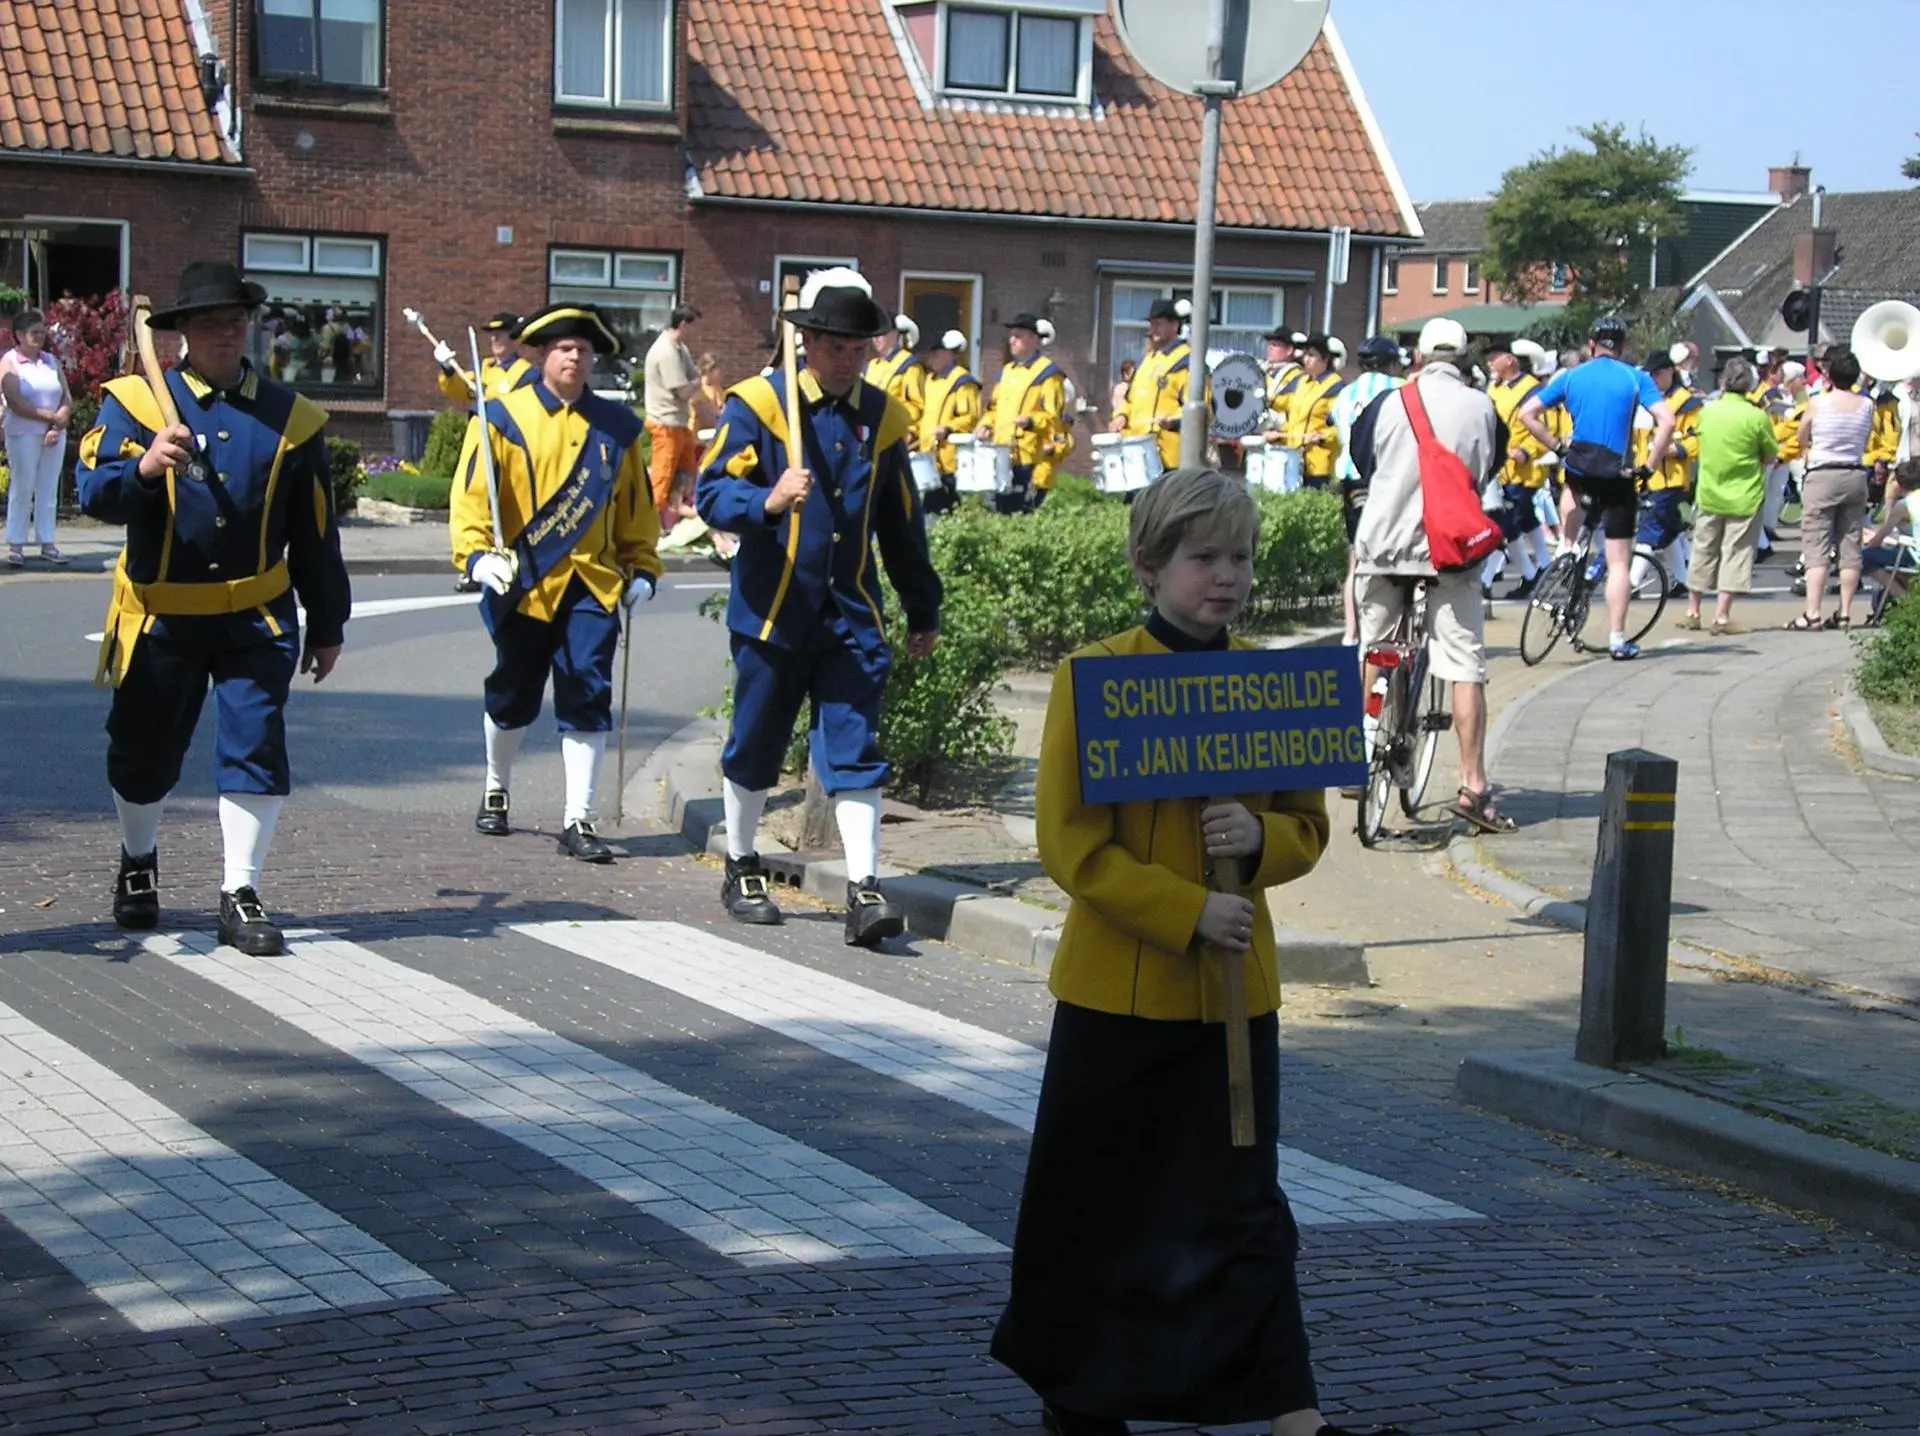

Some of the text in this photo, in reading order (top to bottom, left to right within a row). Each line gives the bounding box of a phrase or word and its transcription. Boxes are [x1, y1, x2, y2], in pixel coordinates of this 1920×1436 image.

[1102, 669, 1341, 719] SCHUTTERSGILDE
[1086, 724, 1365, 780] ST. JAN KEIJENBORG
